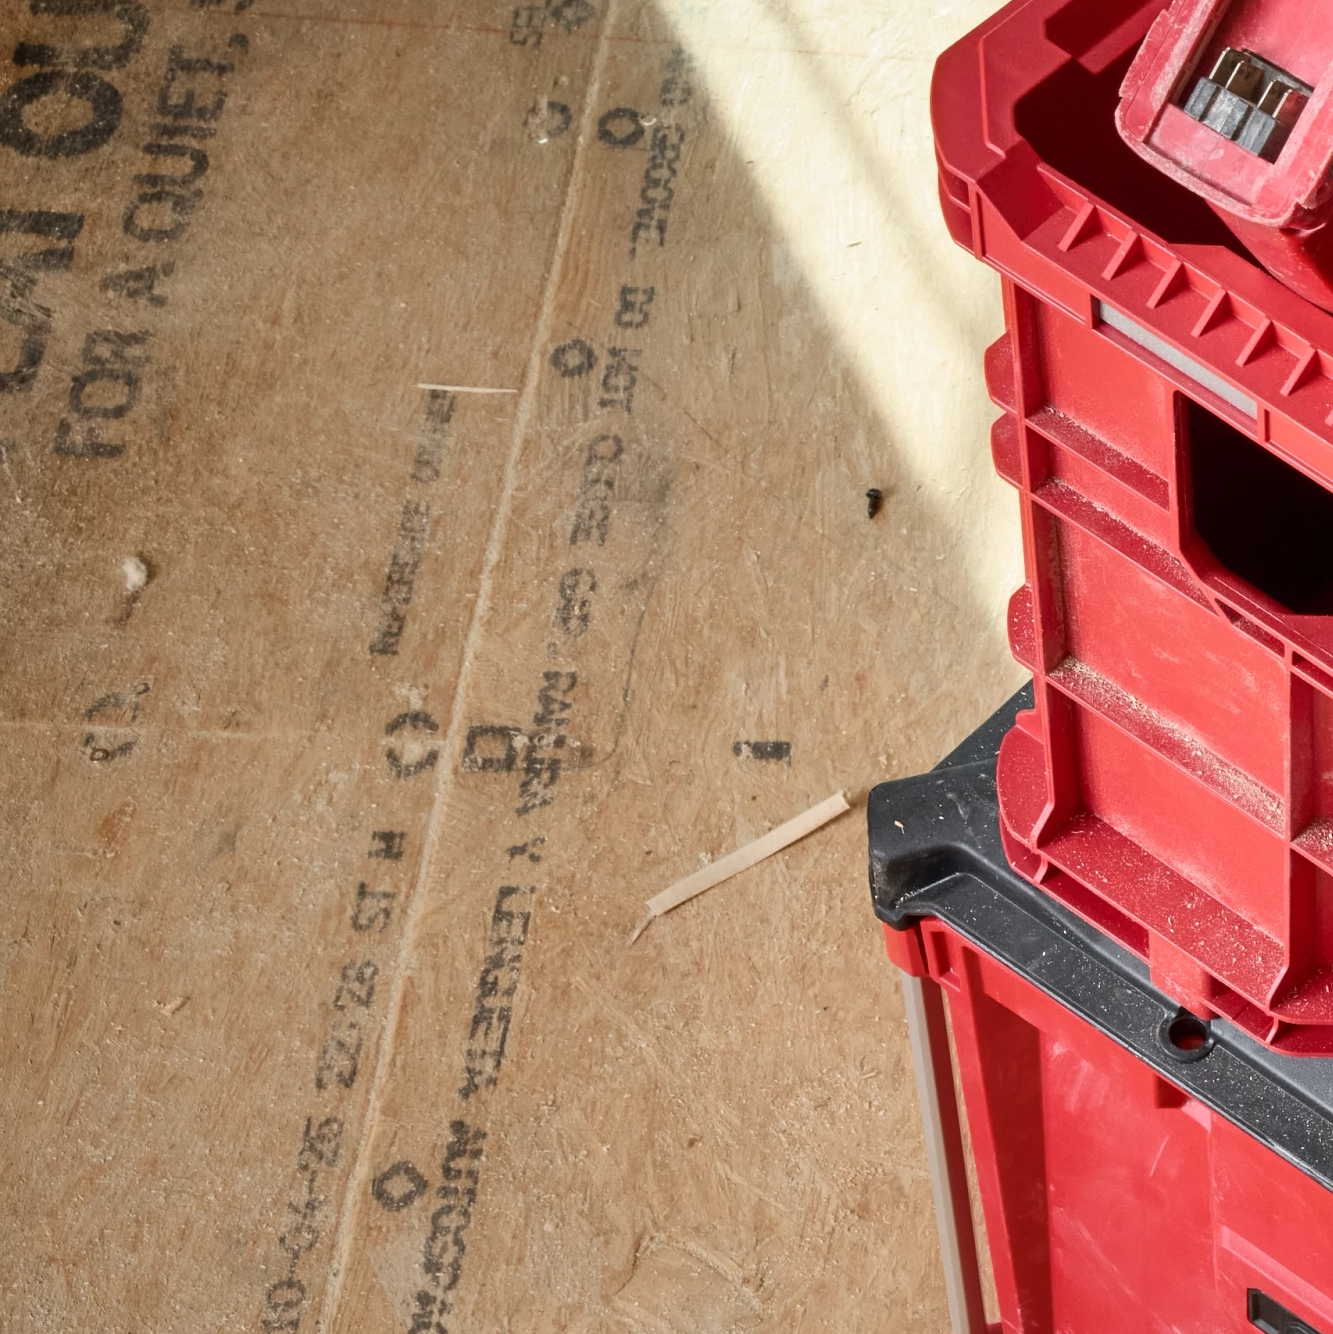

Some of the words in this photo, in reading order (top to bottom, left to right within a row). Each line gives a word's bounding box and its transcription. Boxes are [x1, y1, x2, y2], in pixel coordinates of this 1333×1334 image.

[123, 33, 250, 243] QUIET,
[100, 260, 175, 308] A
[613, 282, 655, 332] DO
[54, 329, 155, 460] FOR
[597, 345, 643, 413] NOT
[569, 433, 628, 545] CLOSE
[506, 830, 545, 864] Y
[348, 883, 398, 936] ST
[456, 887, 539, 1101] LENGUETA
